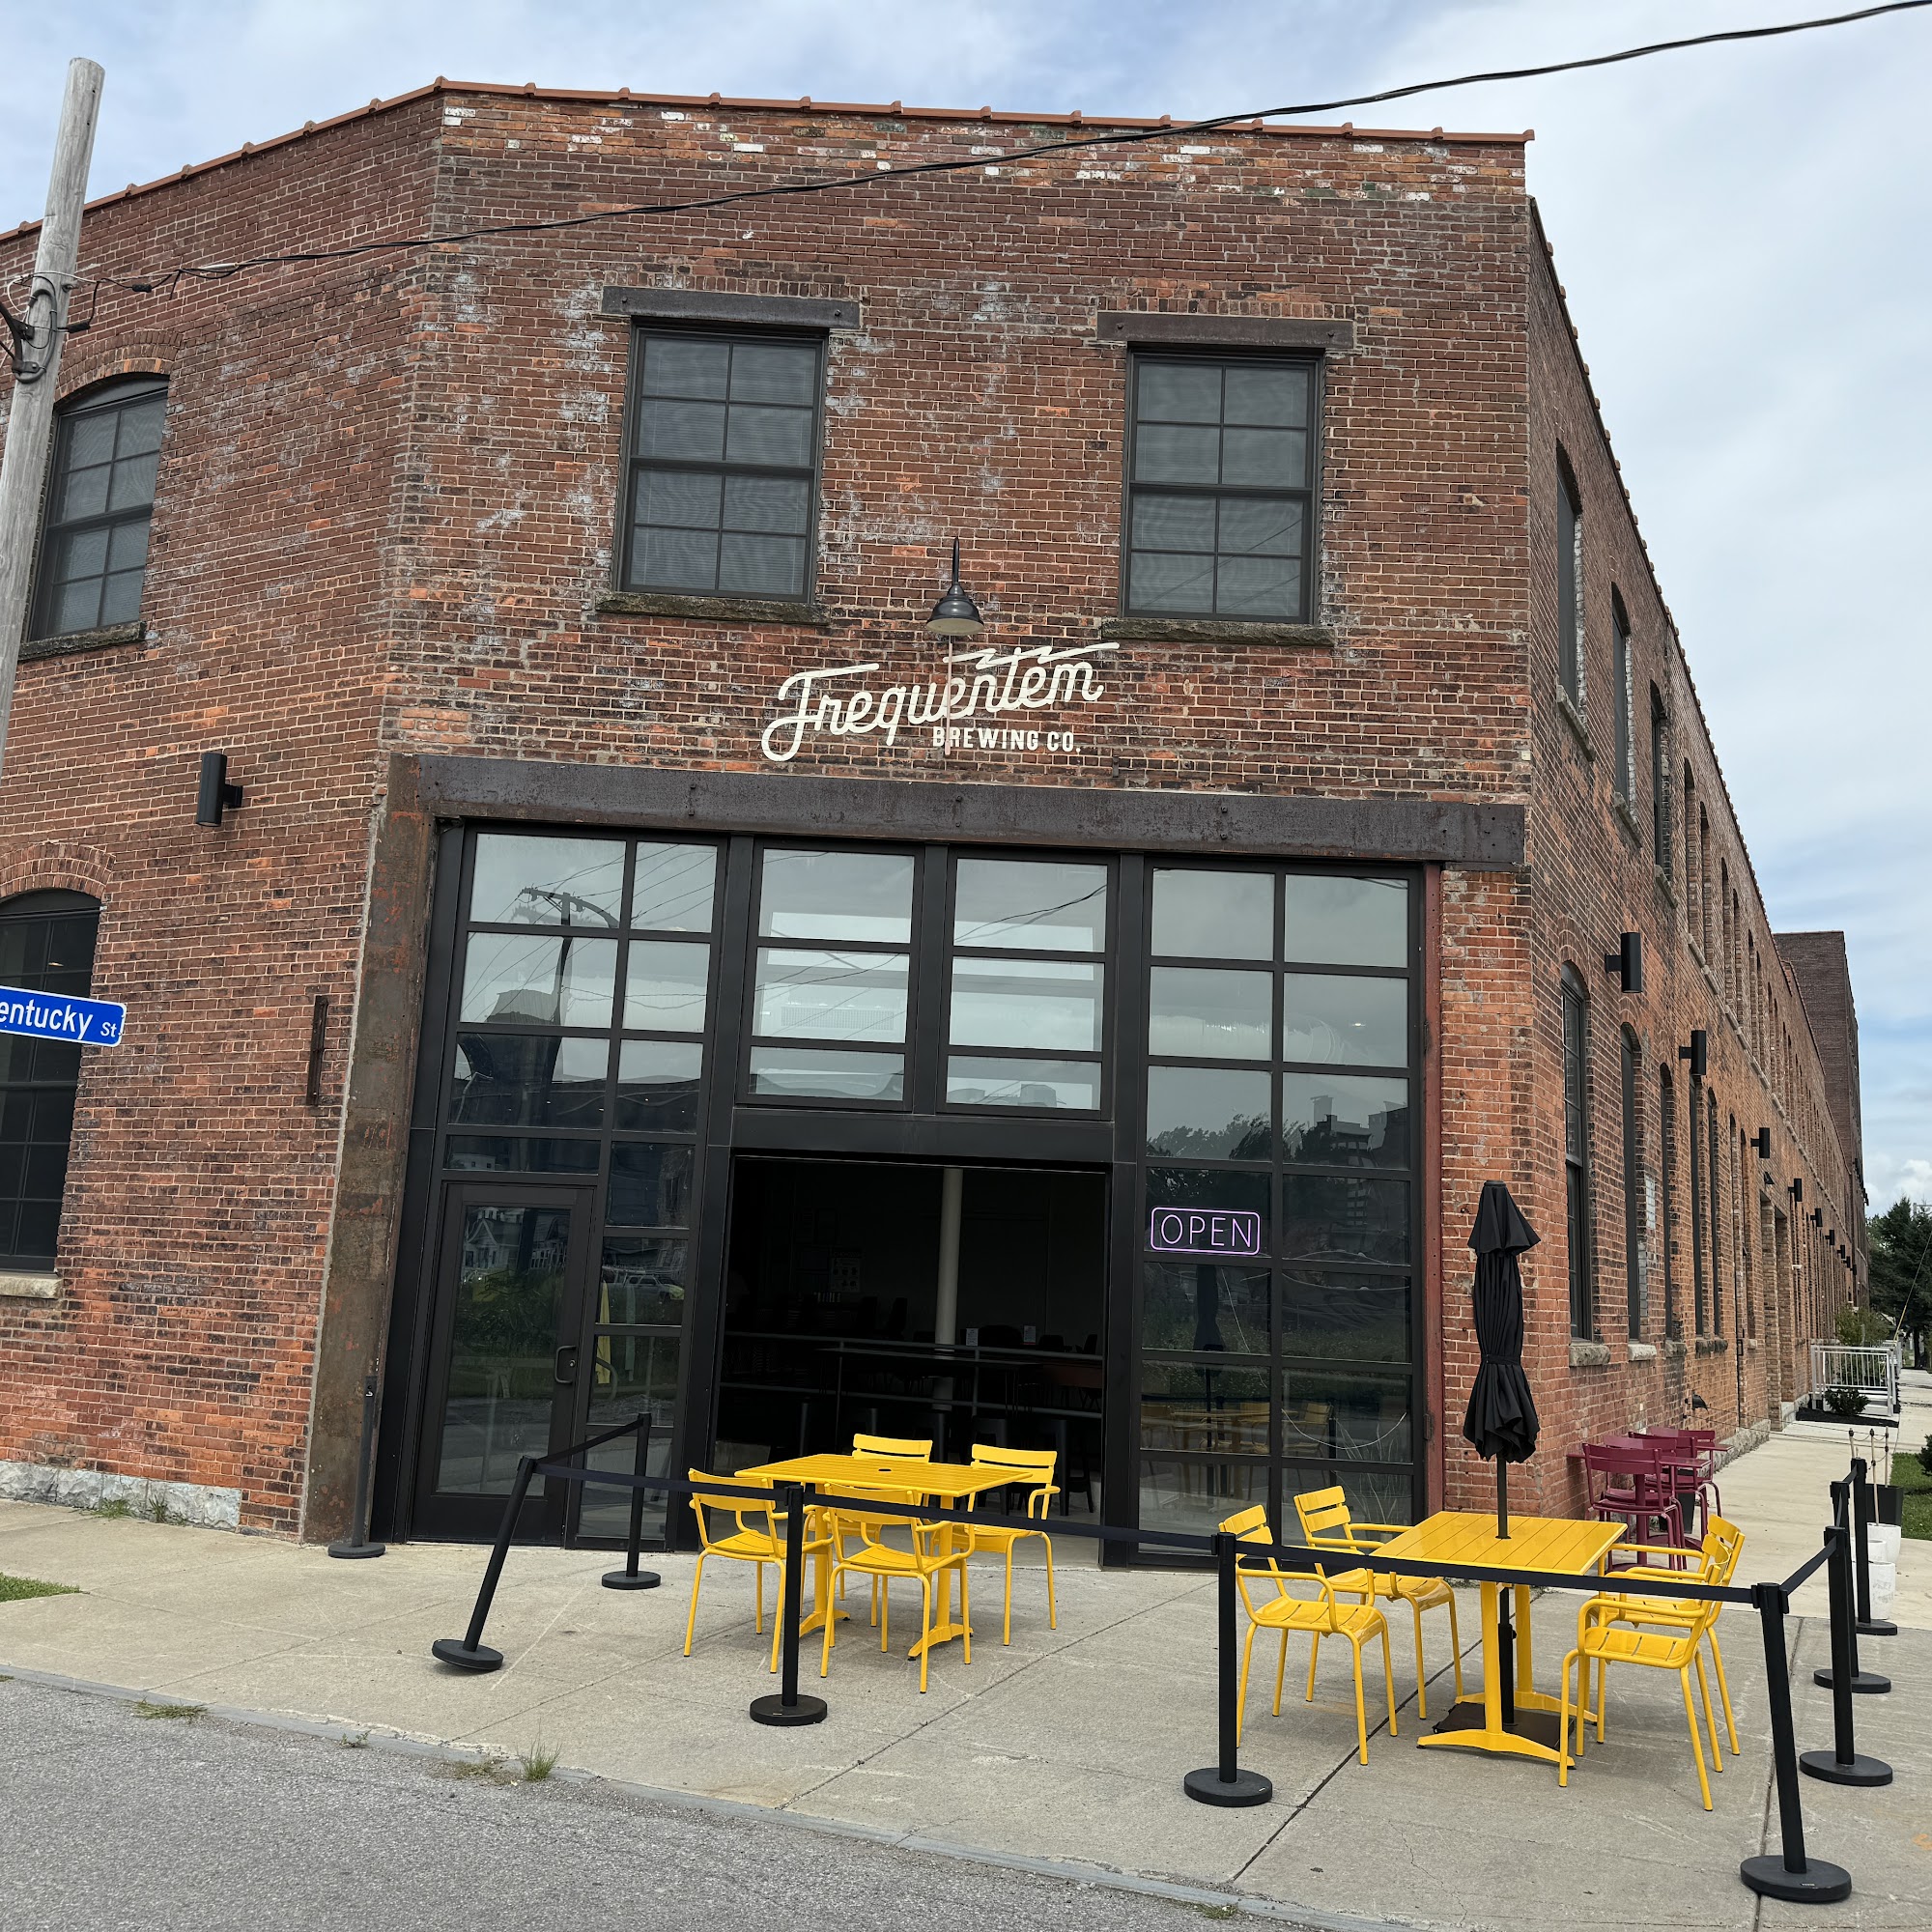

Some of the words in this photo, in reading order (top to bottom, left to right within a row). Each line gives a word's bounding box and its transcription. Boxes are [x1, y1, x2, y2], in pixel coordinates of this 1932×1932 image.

[761, 642, 1121, 762] Frequentem
[932, 726, 1038, 752] BREWING
[1046, 731, 1082, 753] CO.
[100, 1022, 117, 1037] St
[1161, 1214, 1251, 1247] OPEN
